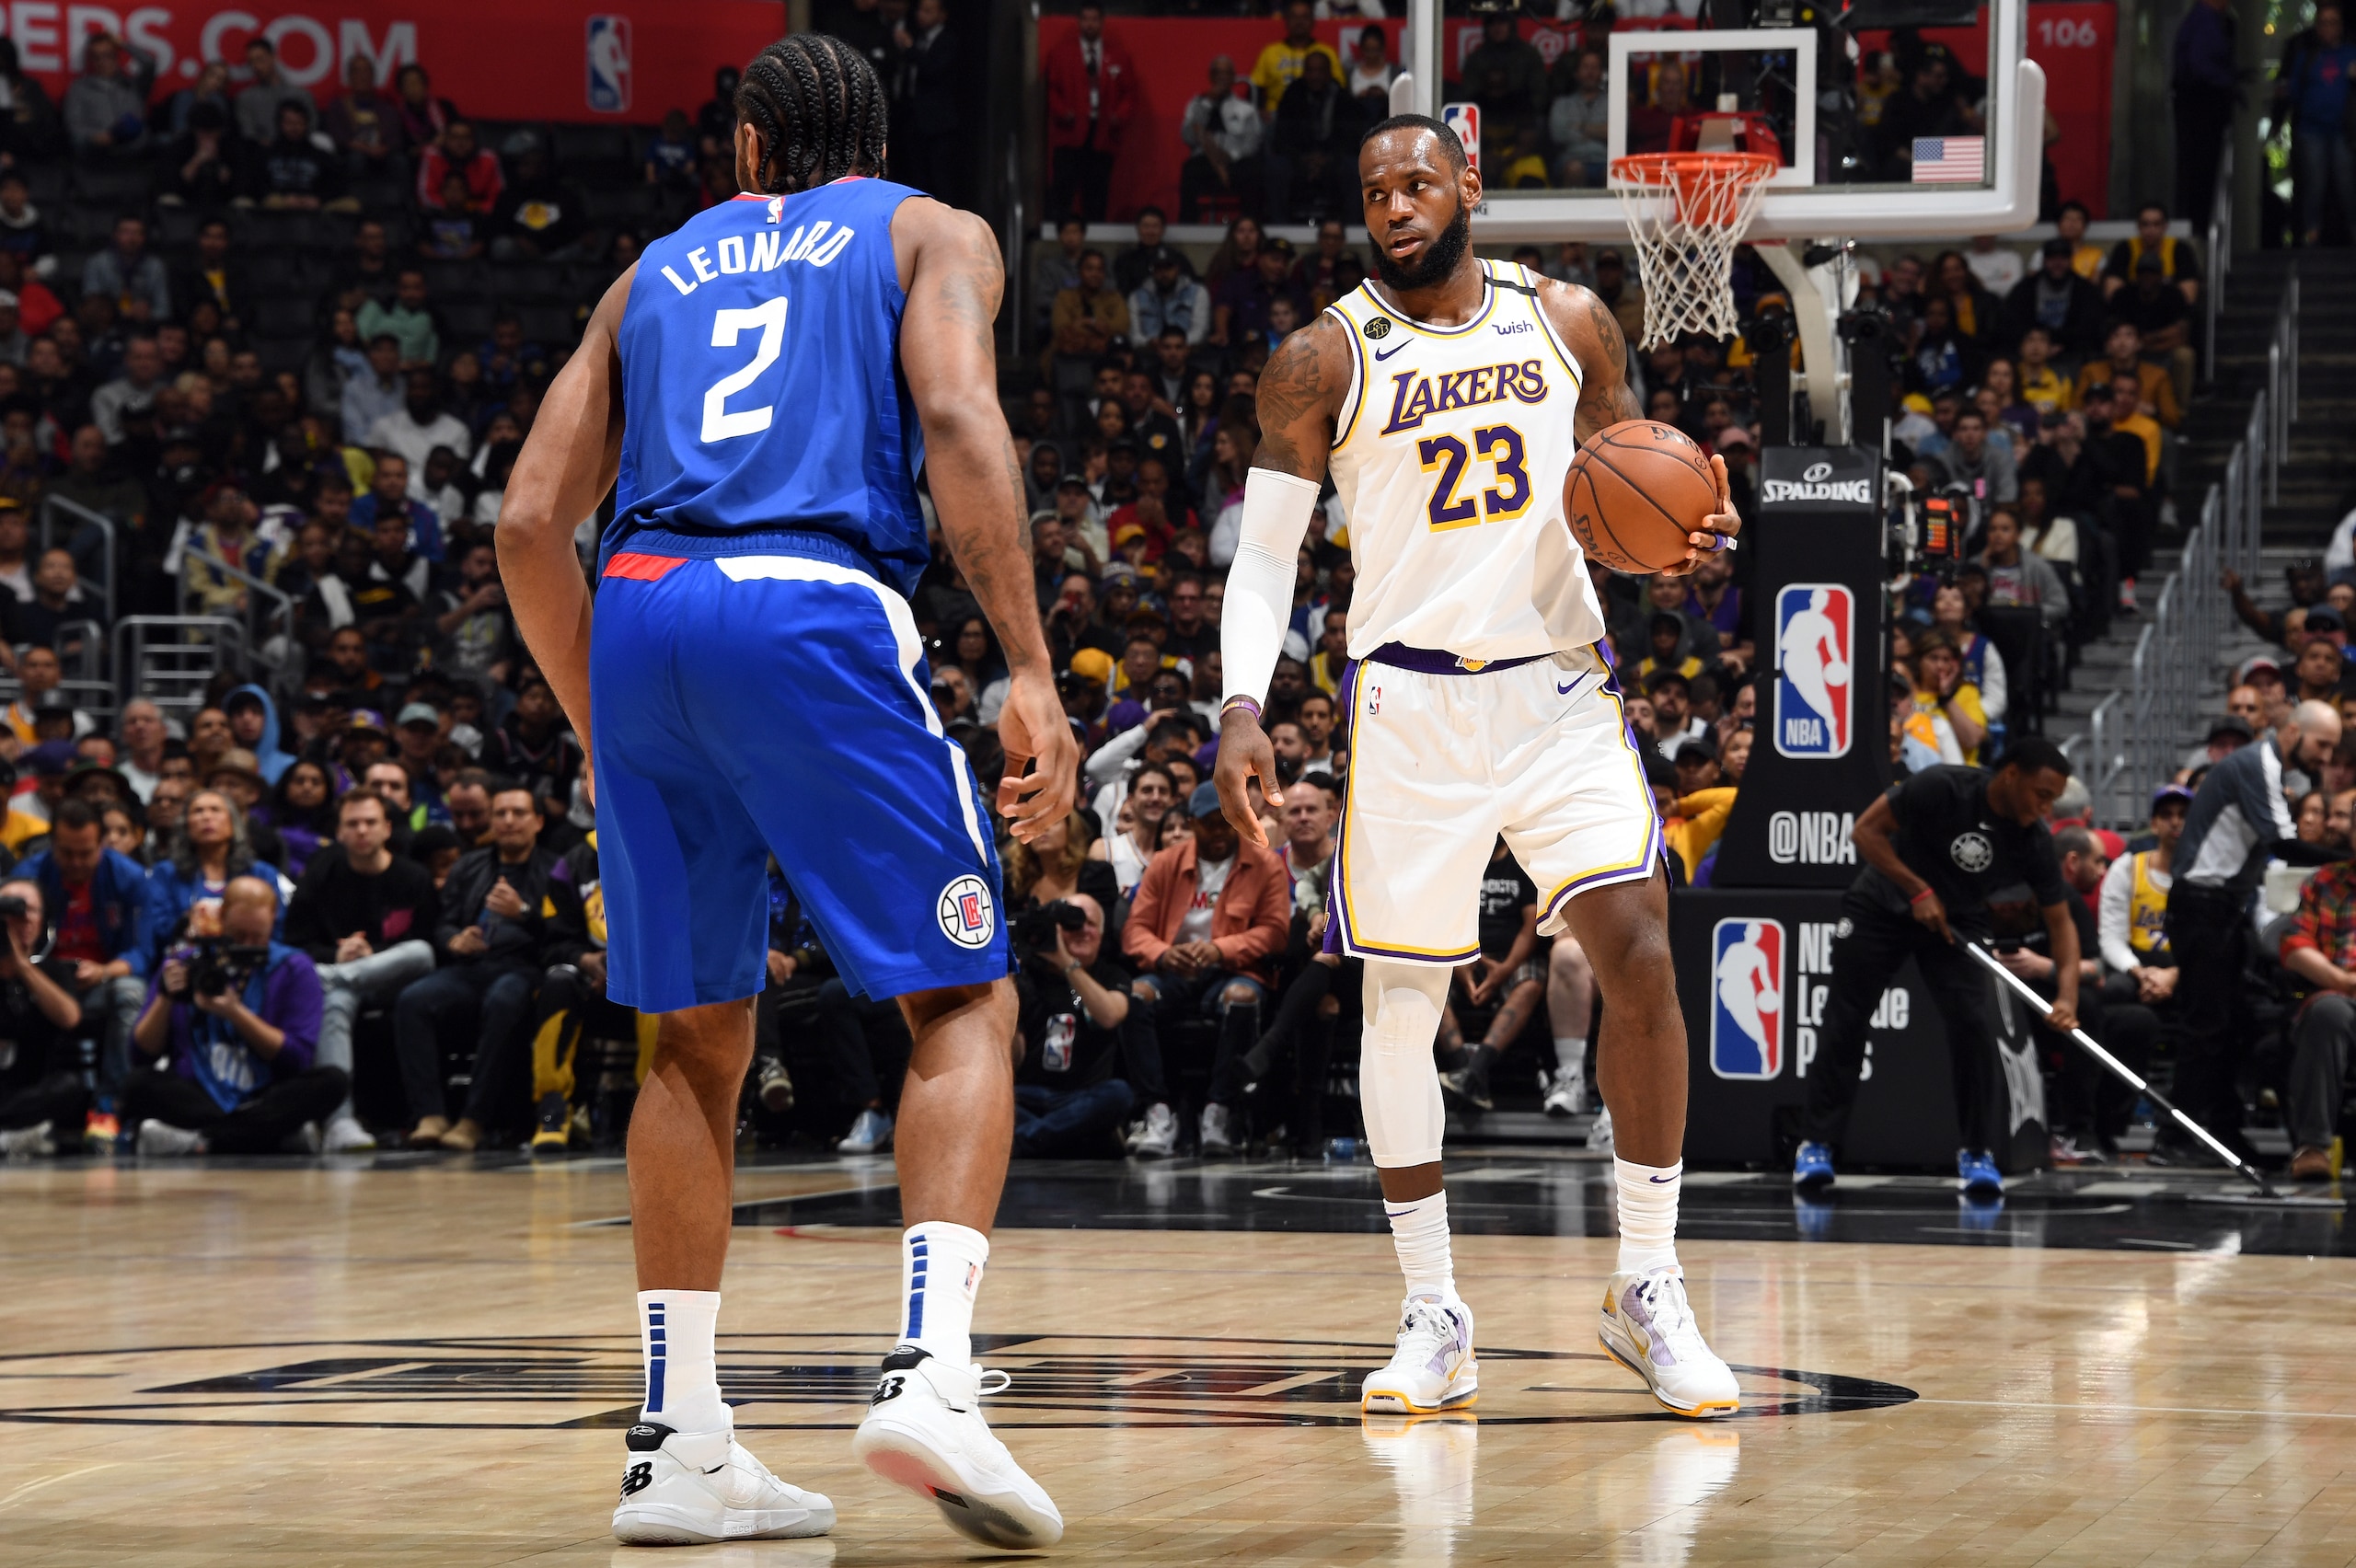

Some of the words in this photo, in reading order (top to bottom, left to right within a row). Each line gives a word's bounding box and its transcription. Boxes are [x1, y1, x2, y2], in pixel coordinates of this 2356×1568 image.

[0, 3, 419, 87] ERS.COM
[2038, 18, 2097, 48] 106
[661, 221, 855, 295] LEONARD
[1491, 319, 1534, 335] wish
[700, 296, 789, 444] 2
[1379, 358, 1550, 439] LAKERS
[1415, 422, 1534, 534] 23
[1762, 478, 1874, 503] SPALDING
[1785, 718, 1822, 746] NBA
[1768, 810, 1857, 865] @NBA
